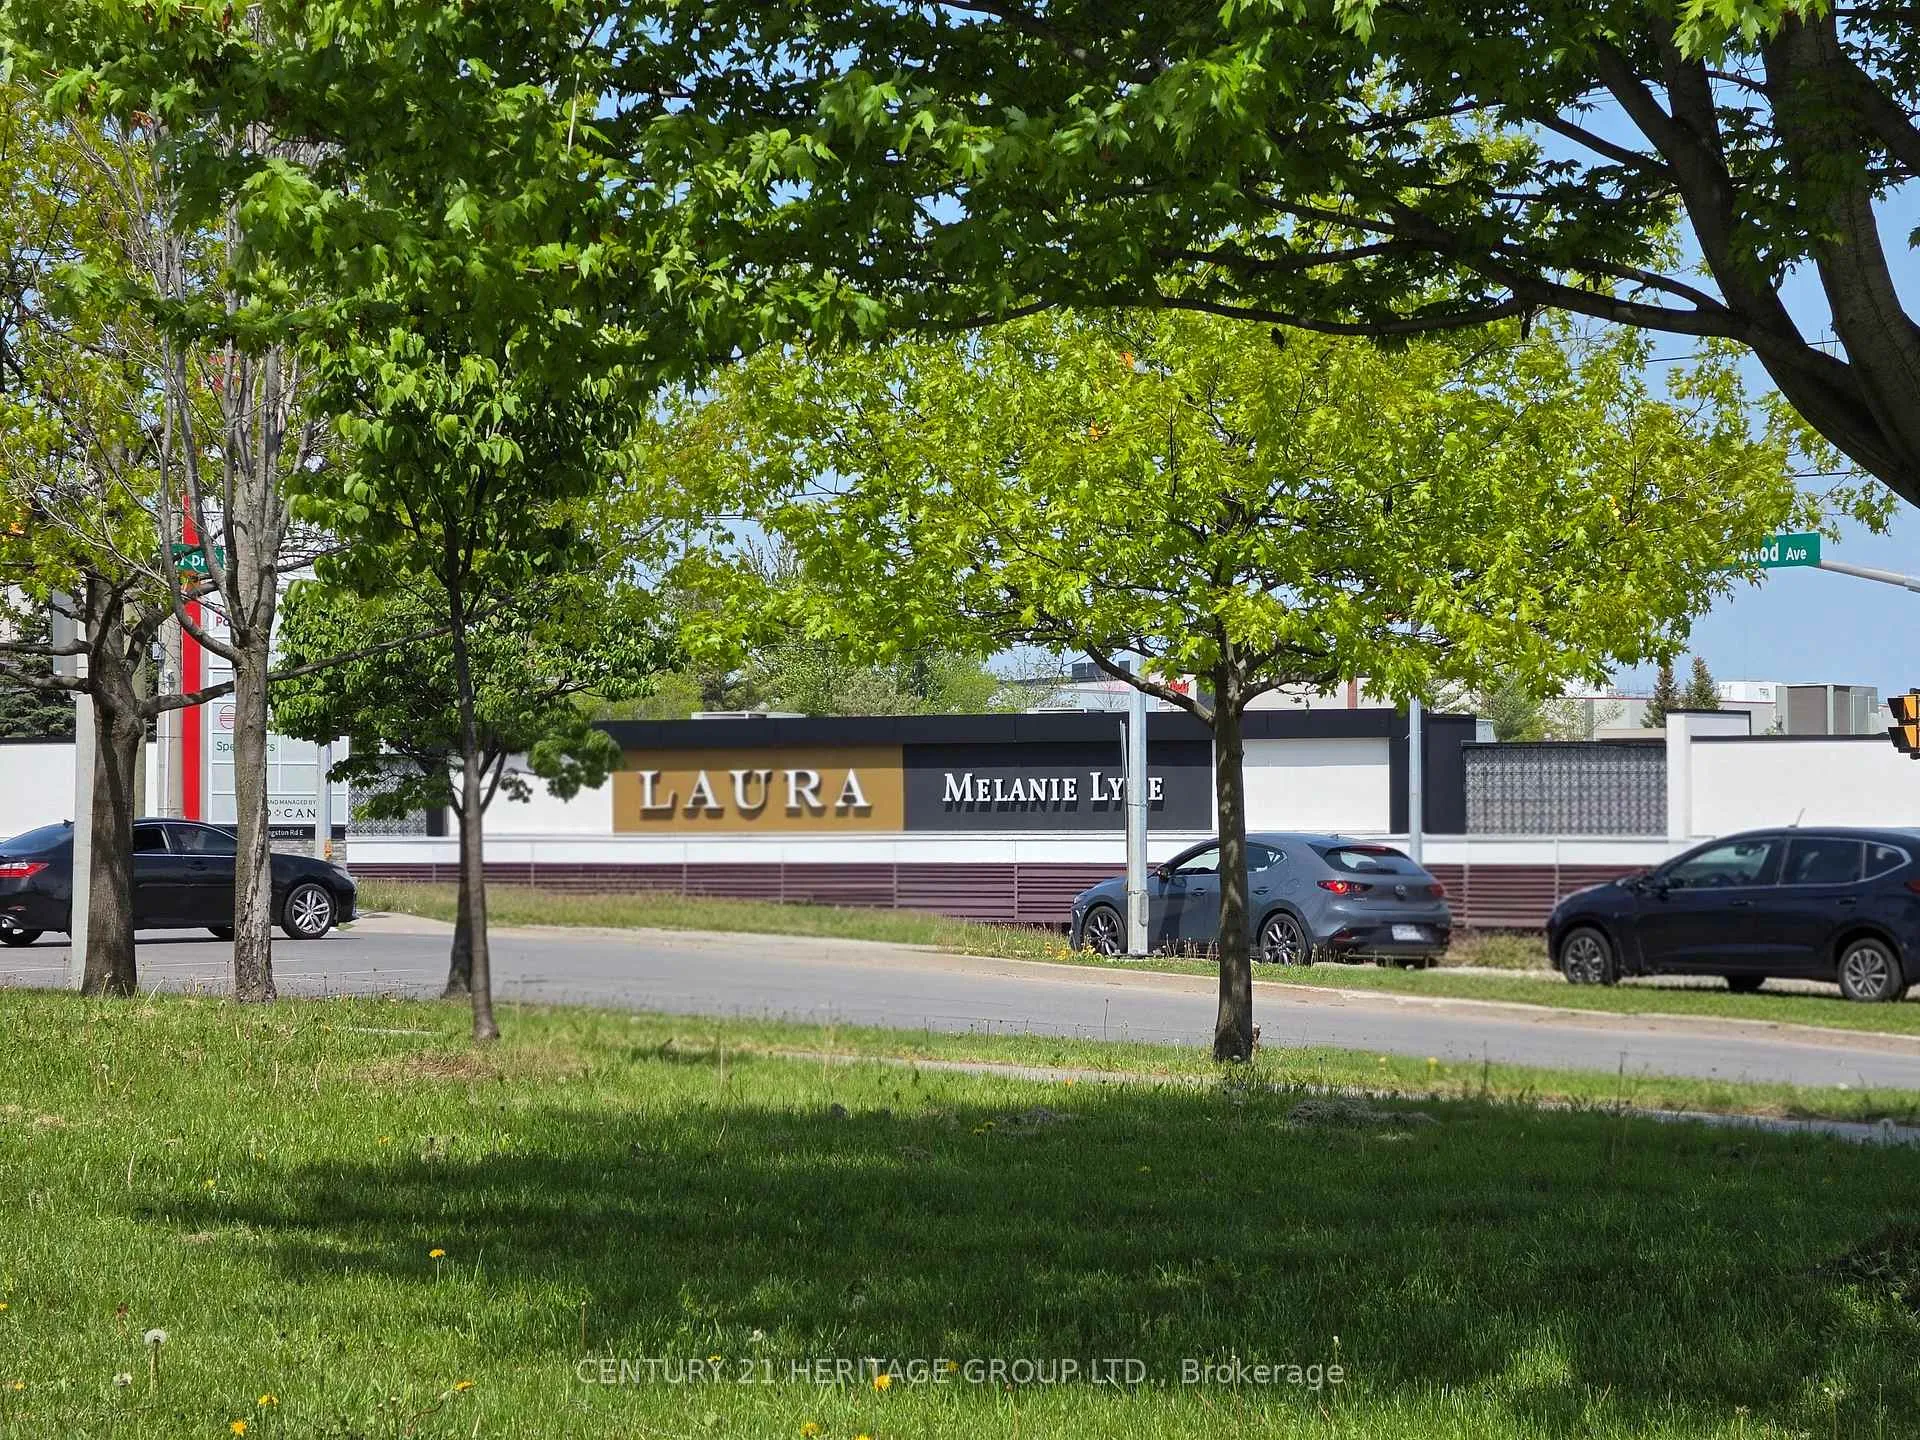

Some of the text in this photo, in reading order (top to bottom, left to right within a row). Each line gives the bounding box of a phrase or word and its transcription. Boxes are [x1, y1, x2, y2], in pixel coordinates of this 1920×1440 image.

[1785, 547, 1807, 561] Ave
[639, 768, 872, 811] LAURA
[943, 771, 1164, 802] MELANIE LYE
